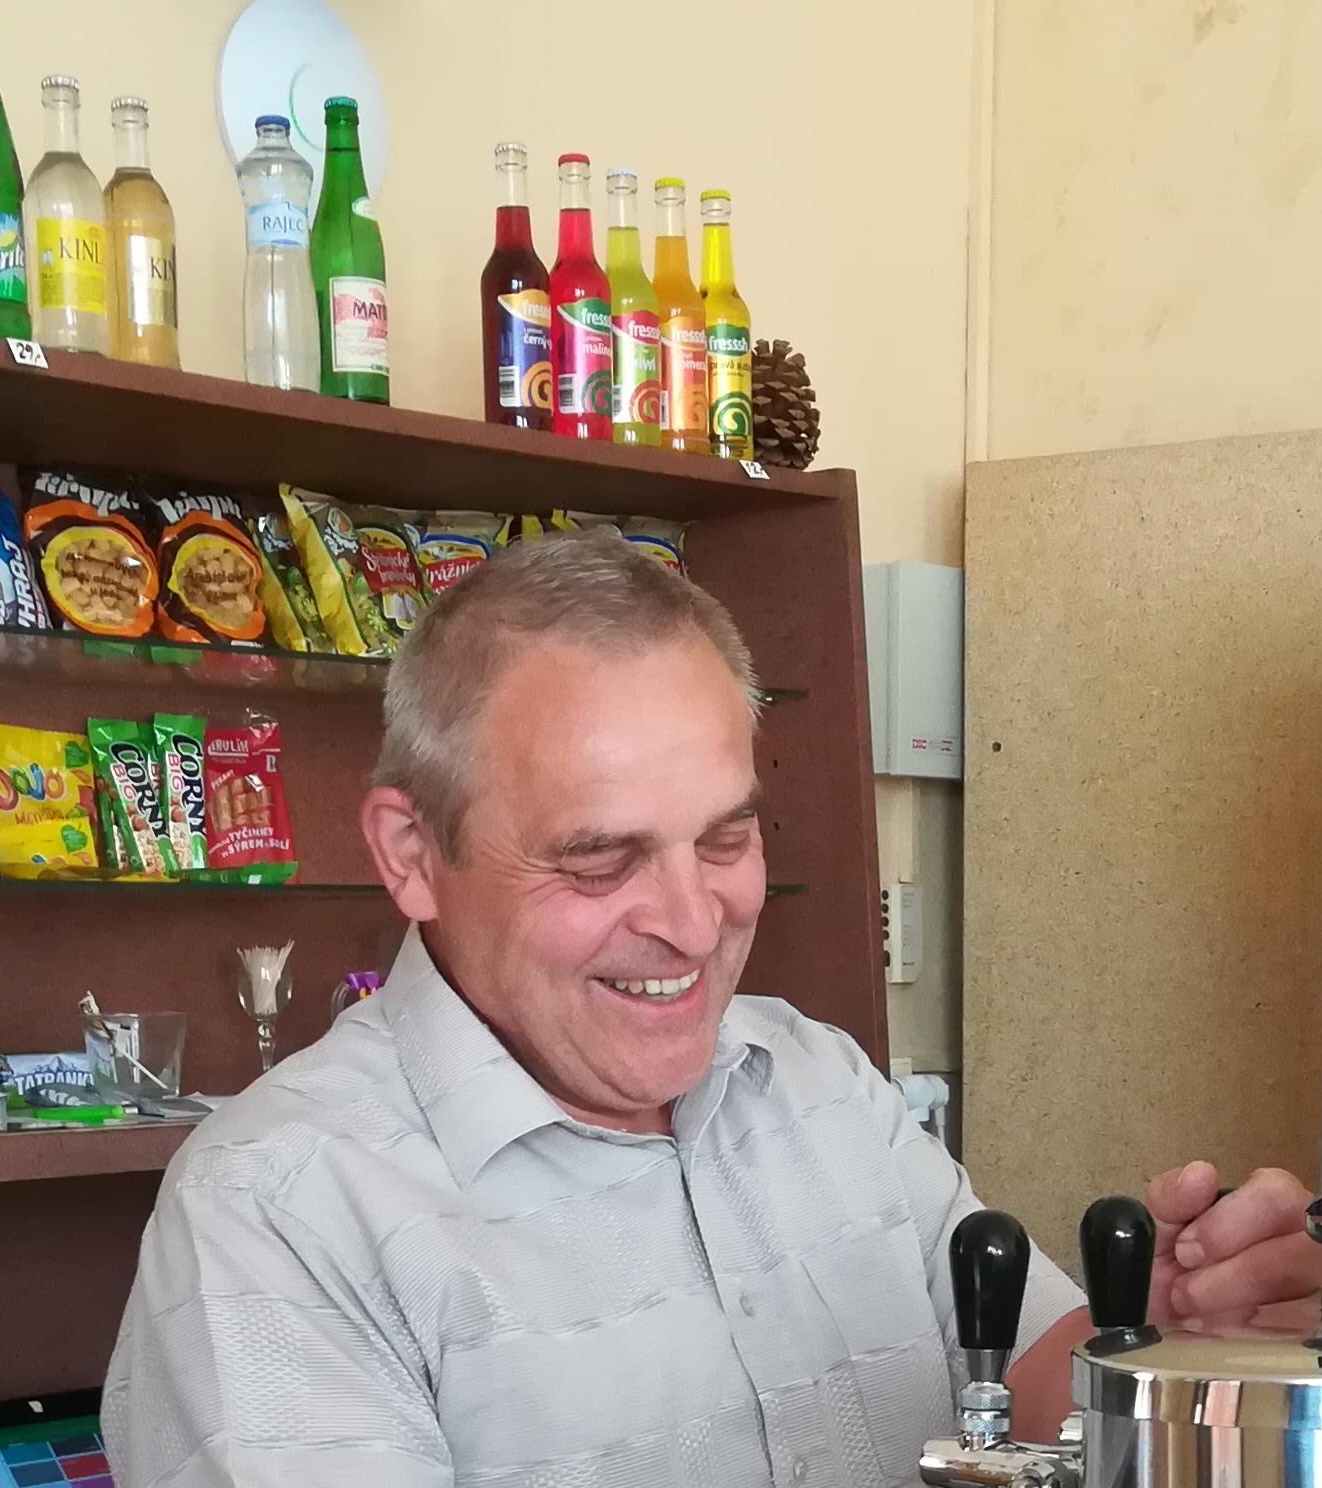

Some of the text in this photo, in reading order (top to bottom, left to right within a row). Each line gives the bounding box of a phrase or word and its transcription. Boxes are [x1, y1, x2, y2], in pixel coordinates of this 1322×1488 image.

[708, 335, 749, 351] fresssh
[109, 742, 171, 840] CORNY
[113, 764, 138, 801] BIG
[167, 753, 184, 791] BIG
[171, 732, 207, 841] CORNY
